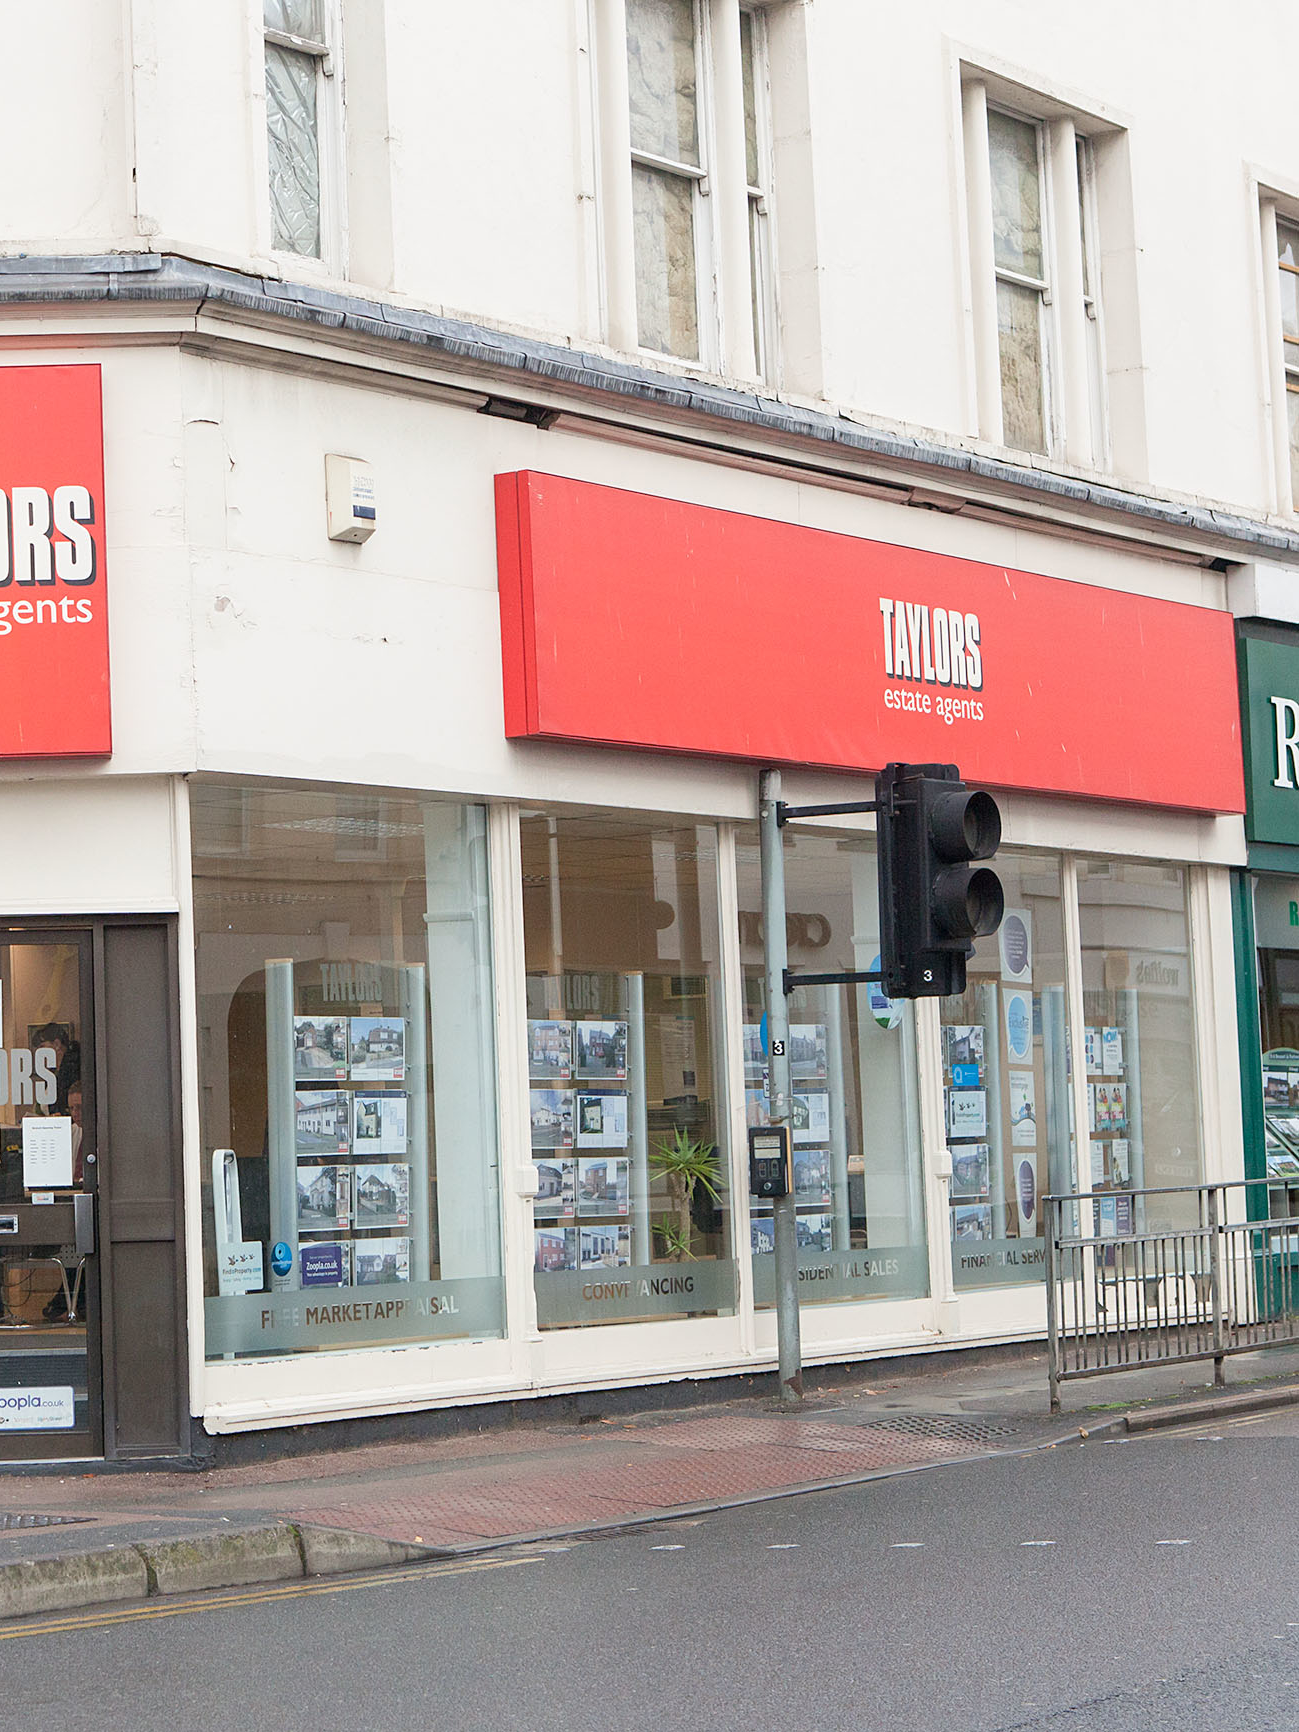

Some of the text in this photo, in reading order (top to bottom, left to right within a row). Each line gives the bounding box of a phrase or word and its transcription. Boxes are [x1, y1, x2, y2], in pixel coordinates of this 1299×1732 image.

[879, 597, 983, 692] TAYLORS
[884, 688, 984, 725] estate agents
[923, 969, 933, 982] 3
[773, 1041, 784, 1054] 3
[306, 1261, 338, 1272] Zoopla.co.uk
[798, 1259, 899, 1281] SIDENIAL SALES
[305, 1303, 372, 1326] MARKET
